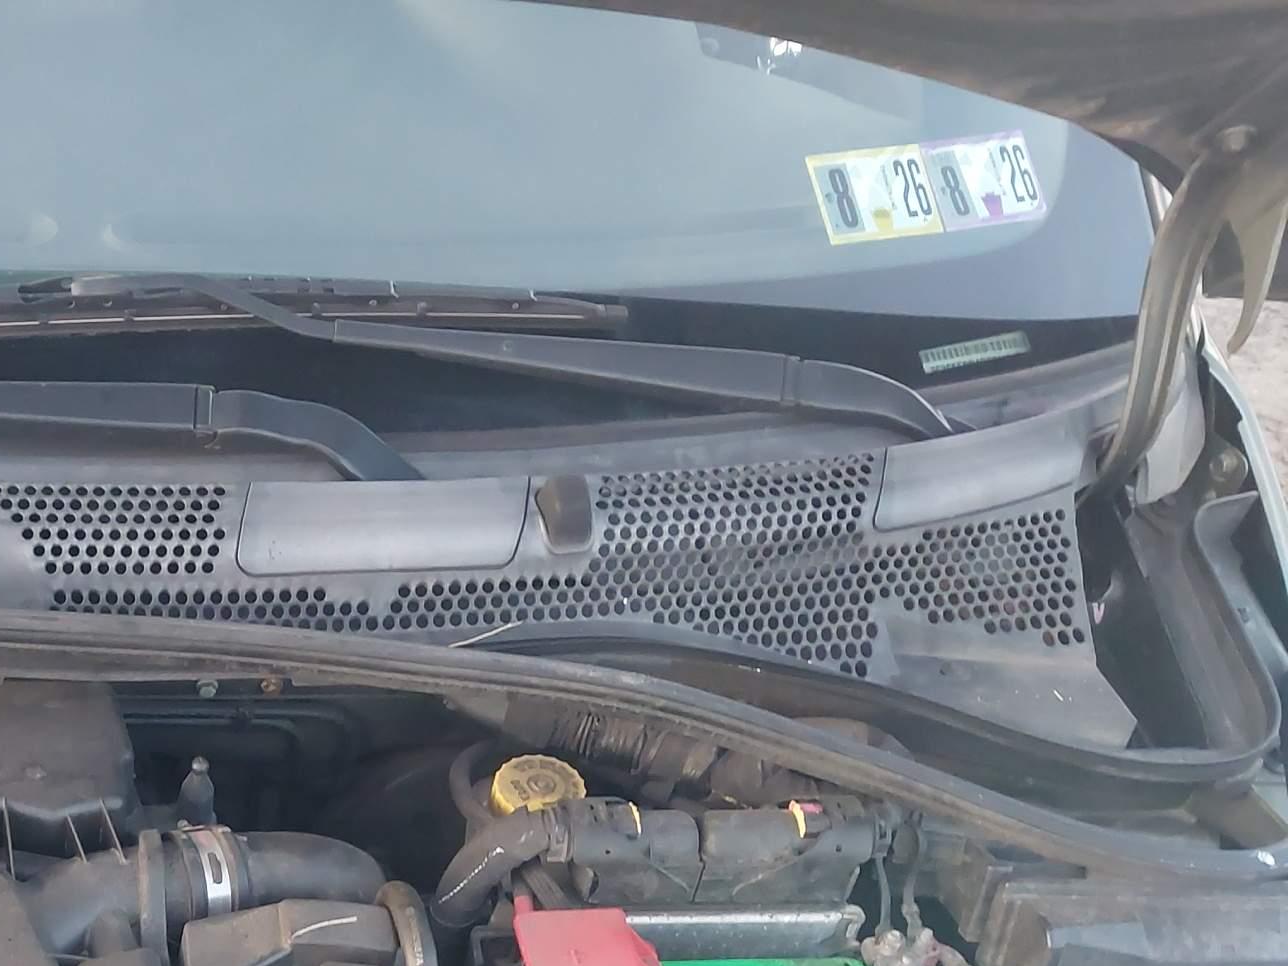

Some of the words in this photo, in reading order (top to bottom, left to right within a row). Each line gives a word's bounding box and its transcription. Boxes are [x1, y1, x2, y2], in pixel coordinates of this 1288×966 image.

[828, 168, 859, 228] 8
[893, 158, 932, 217] 26
[941, 166, 970, 216] 8
[1000, 144, 1038, 202] 26
